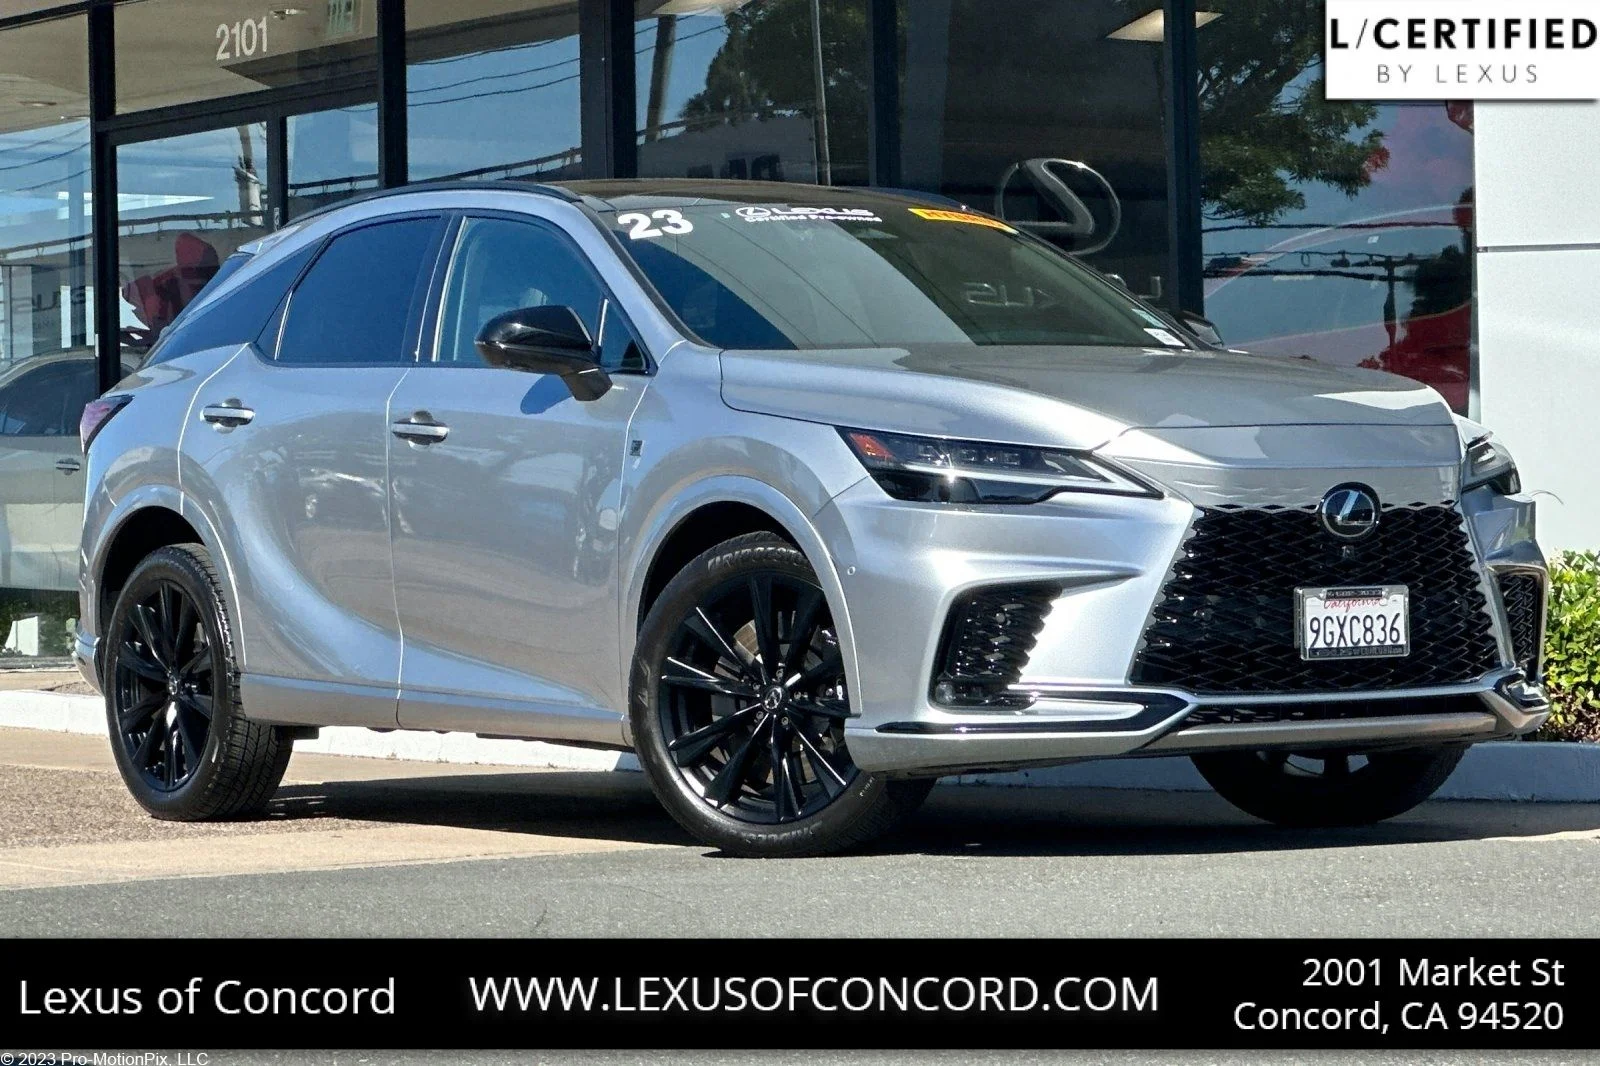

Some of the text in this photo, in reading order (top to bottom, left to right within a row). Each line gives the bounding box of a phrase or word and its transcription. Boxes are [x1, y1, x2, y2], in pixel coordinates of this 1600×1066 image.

[216, 16, 268, 61] 2101
[617, 209, 693, 240] 23
[770, 207, 874, 217] LEXUS
[1309, 612, 1401, 648] 9GXC836
